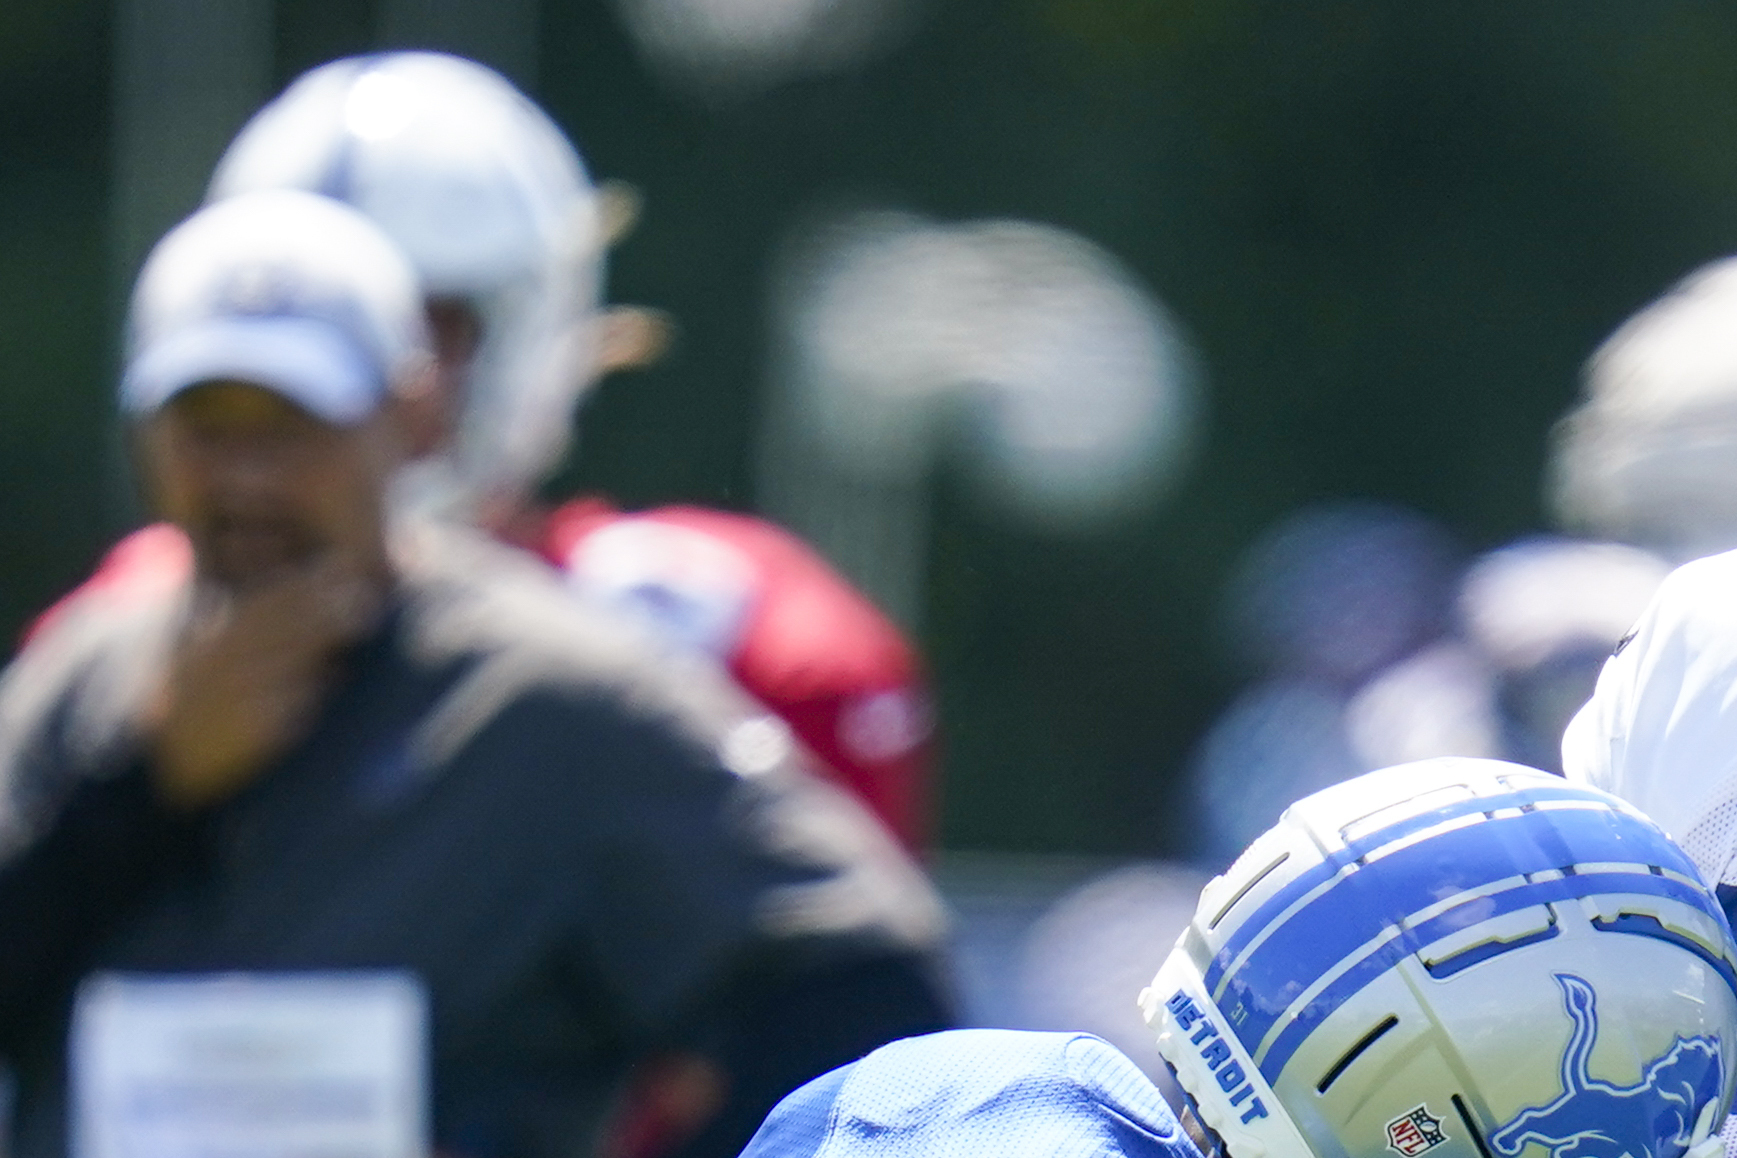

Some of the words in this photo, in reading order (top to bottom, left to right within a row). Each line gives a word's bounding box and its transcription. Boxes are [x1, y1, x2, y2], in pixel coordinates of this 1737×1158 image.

[1230, 1001, 1249, 1027] 31
[1165, 989, 1269, 1124] DETROIT
[1392, 1119, 1425, 1154] NFL
